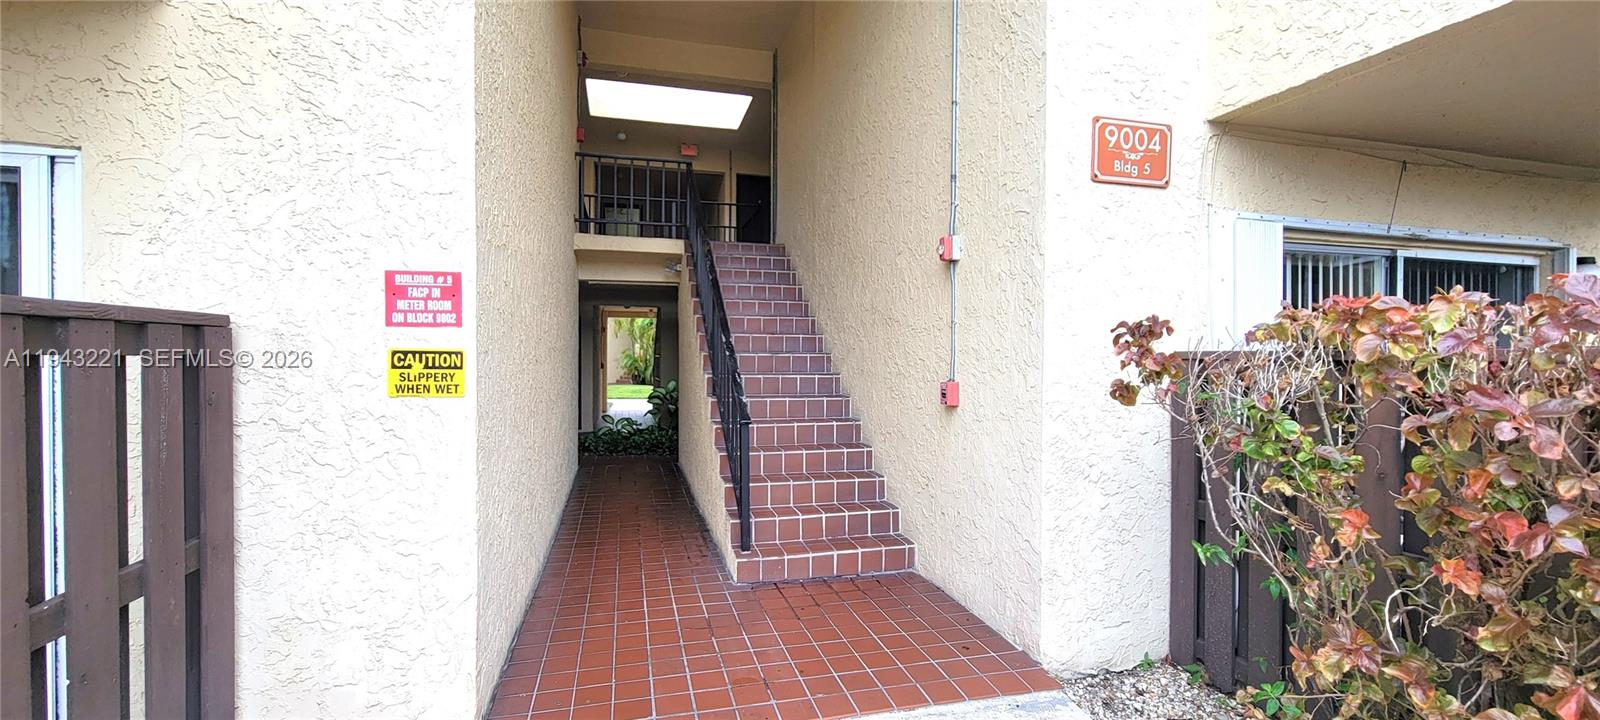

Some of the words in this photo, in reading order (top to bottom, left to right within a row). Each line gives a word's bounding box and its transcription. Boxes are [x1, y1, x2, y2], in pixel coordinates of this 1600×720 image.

[1105, 125, 1161, 152] 9004
[1114, 160, 1138, 177] Bldg
[1143, 163, 1151, 175] 5
[395, 274, 434, 284] BUILDING
[446, 275, 452, 284] 5
[408, 287, 429, 298] FACP
[432, 288, 441, 298] IN
[397, 300, 425, 310] METER
[428, 300, 452, 311] ROOM
[392, 312, 404, 323] ON
[407, 313, 434, 323] BLOCK
[393, 353, 462, 367] CAUTION
[399, 372, 456, 382] SLIPPERY
[395, 384, 431, 394] WHEN
[435, 384, 459, 394] WET
